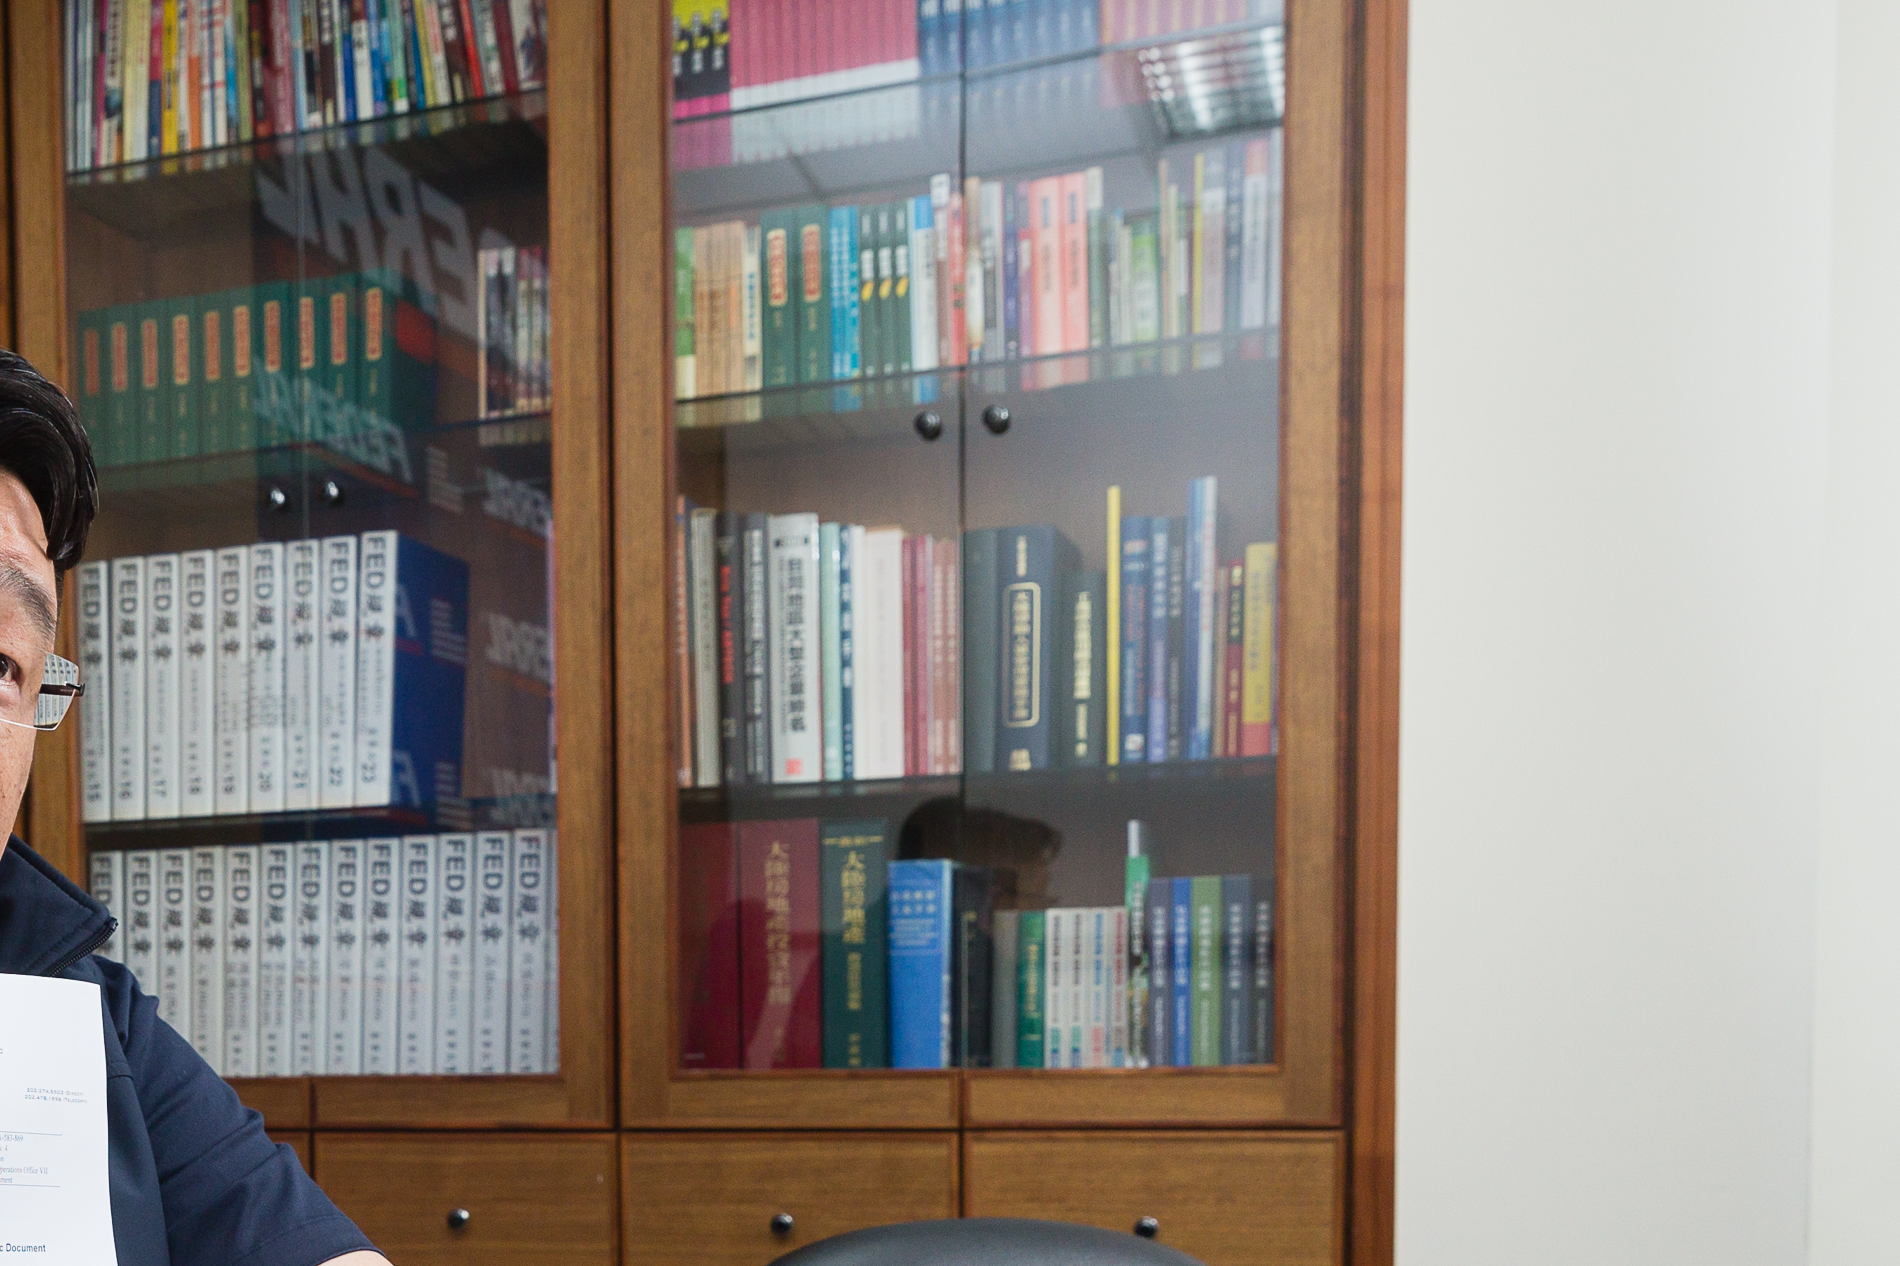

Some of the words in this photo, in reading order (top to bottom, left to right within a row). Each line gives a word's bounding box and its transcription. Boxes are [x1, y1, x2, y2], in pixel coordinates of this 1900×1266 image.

[4, 1144, 8, 1152] 4
[22, 1166, 38, 1174] Office
[39, 1166, 48, 1174] VII
[5, 1243, 46, 1252] Document
